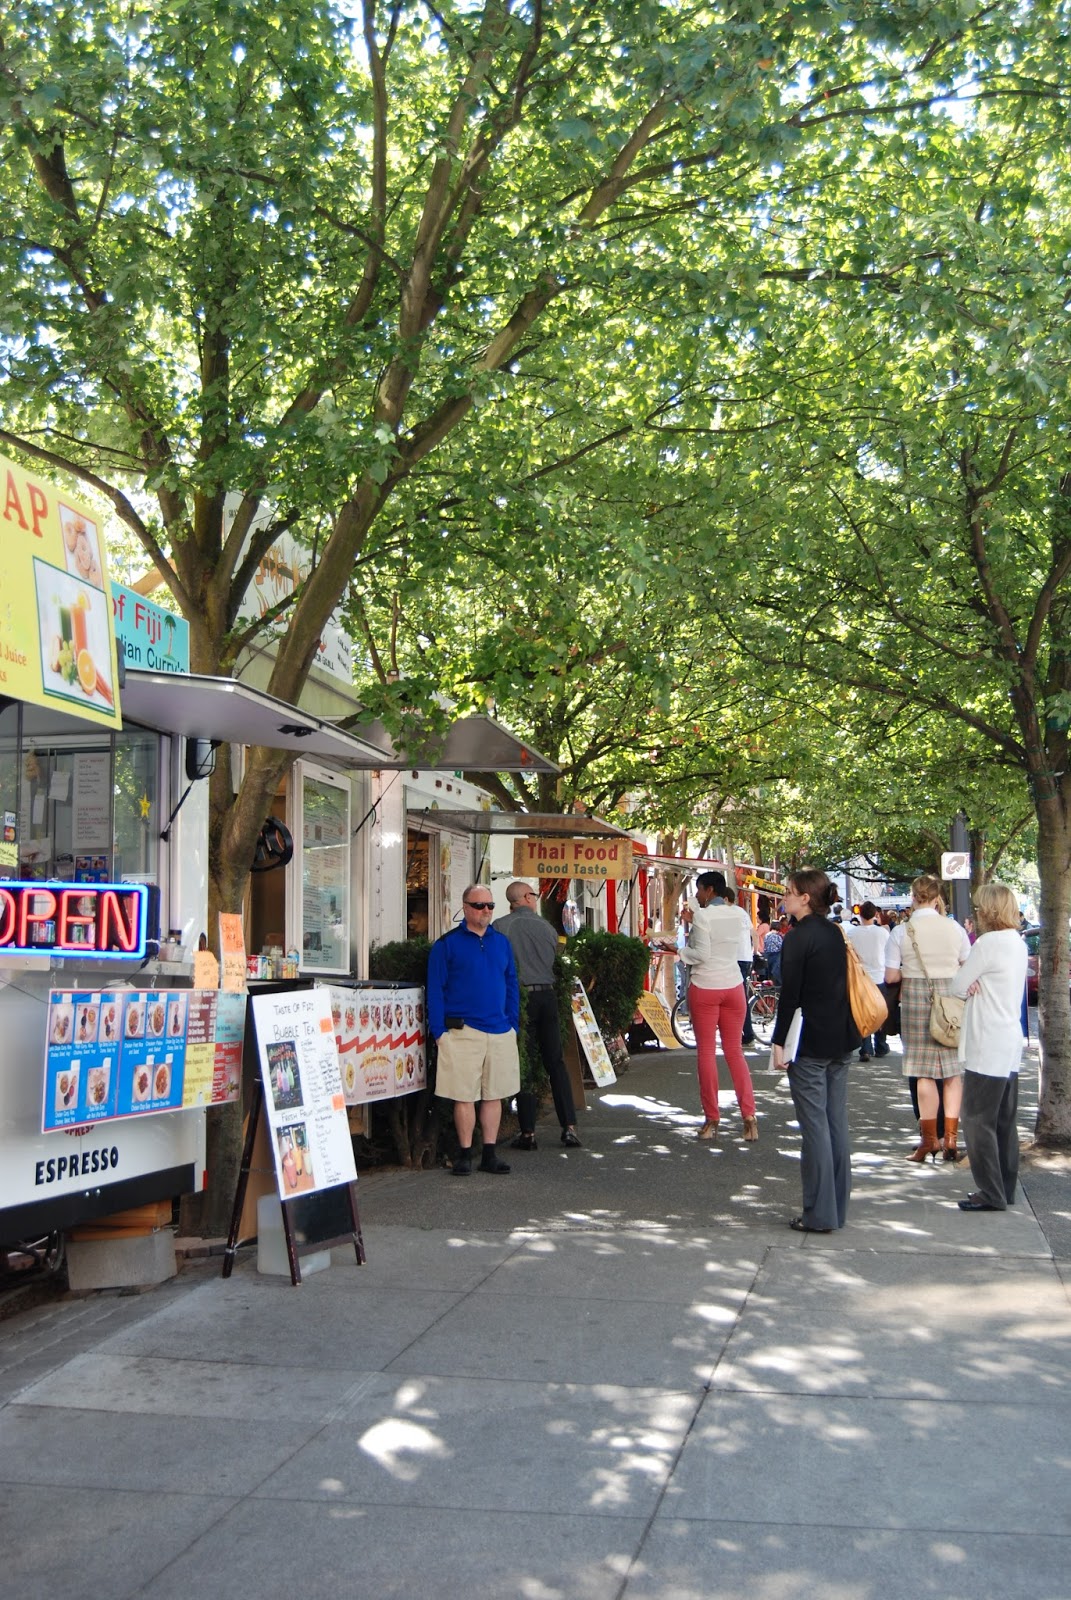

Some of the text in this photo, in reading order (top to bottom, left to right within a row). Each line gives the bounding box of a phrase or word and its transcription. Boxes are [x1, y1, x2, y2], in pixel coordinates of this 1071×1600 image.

[3, 469, 48, 538] AP
[135, 603, 161, 645] Fiji
[5, 645, 27, 667] Juice
[527, 843, 619, 861] Thai Food
[537, 862, 608, 875] Good Taste
[272, 1021, 316, 1042] BUBBLE TEA
[35, 1146, 119, 1186] ESPRESSO
